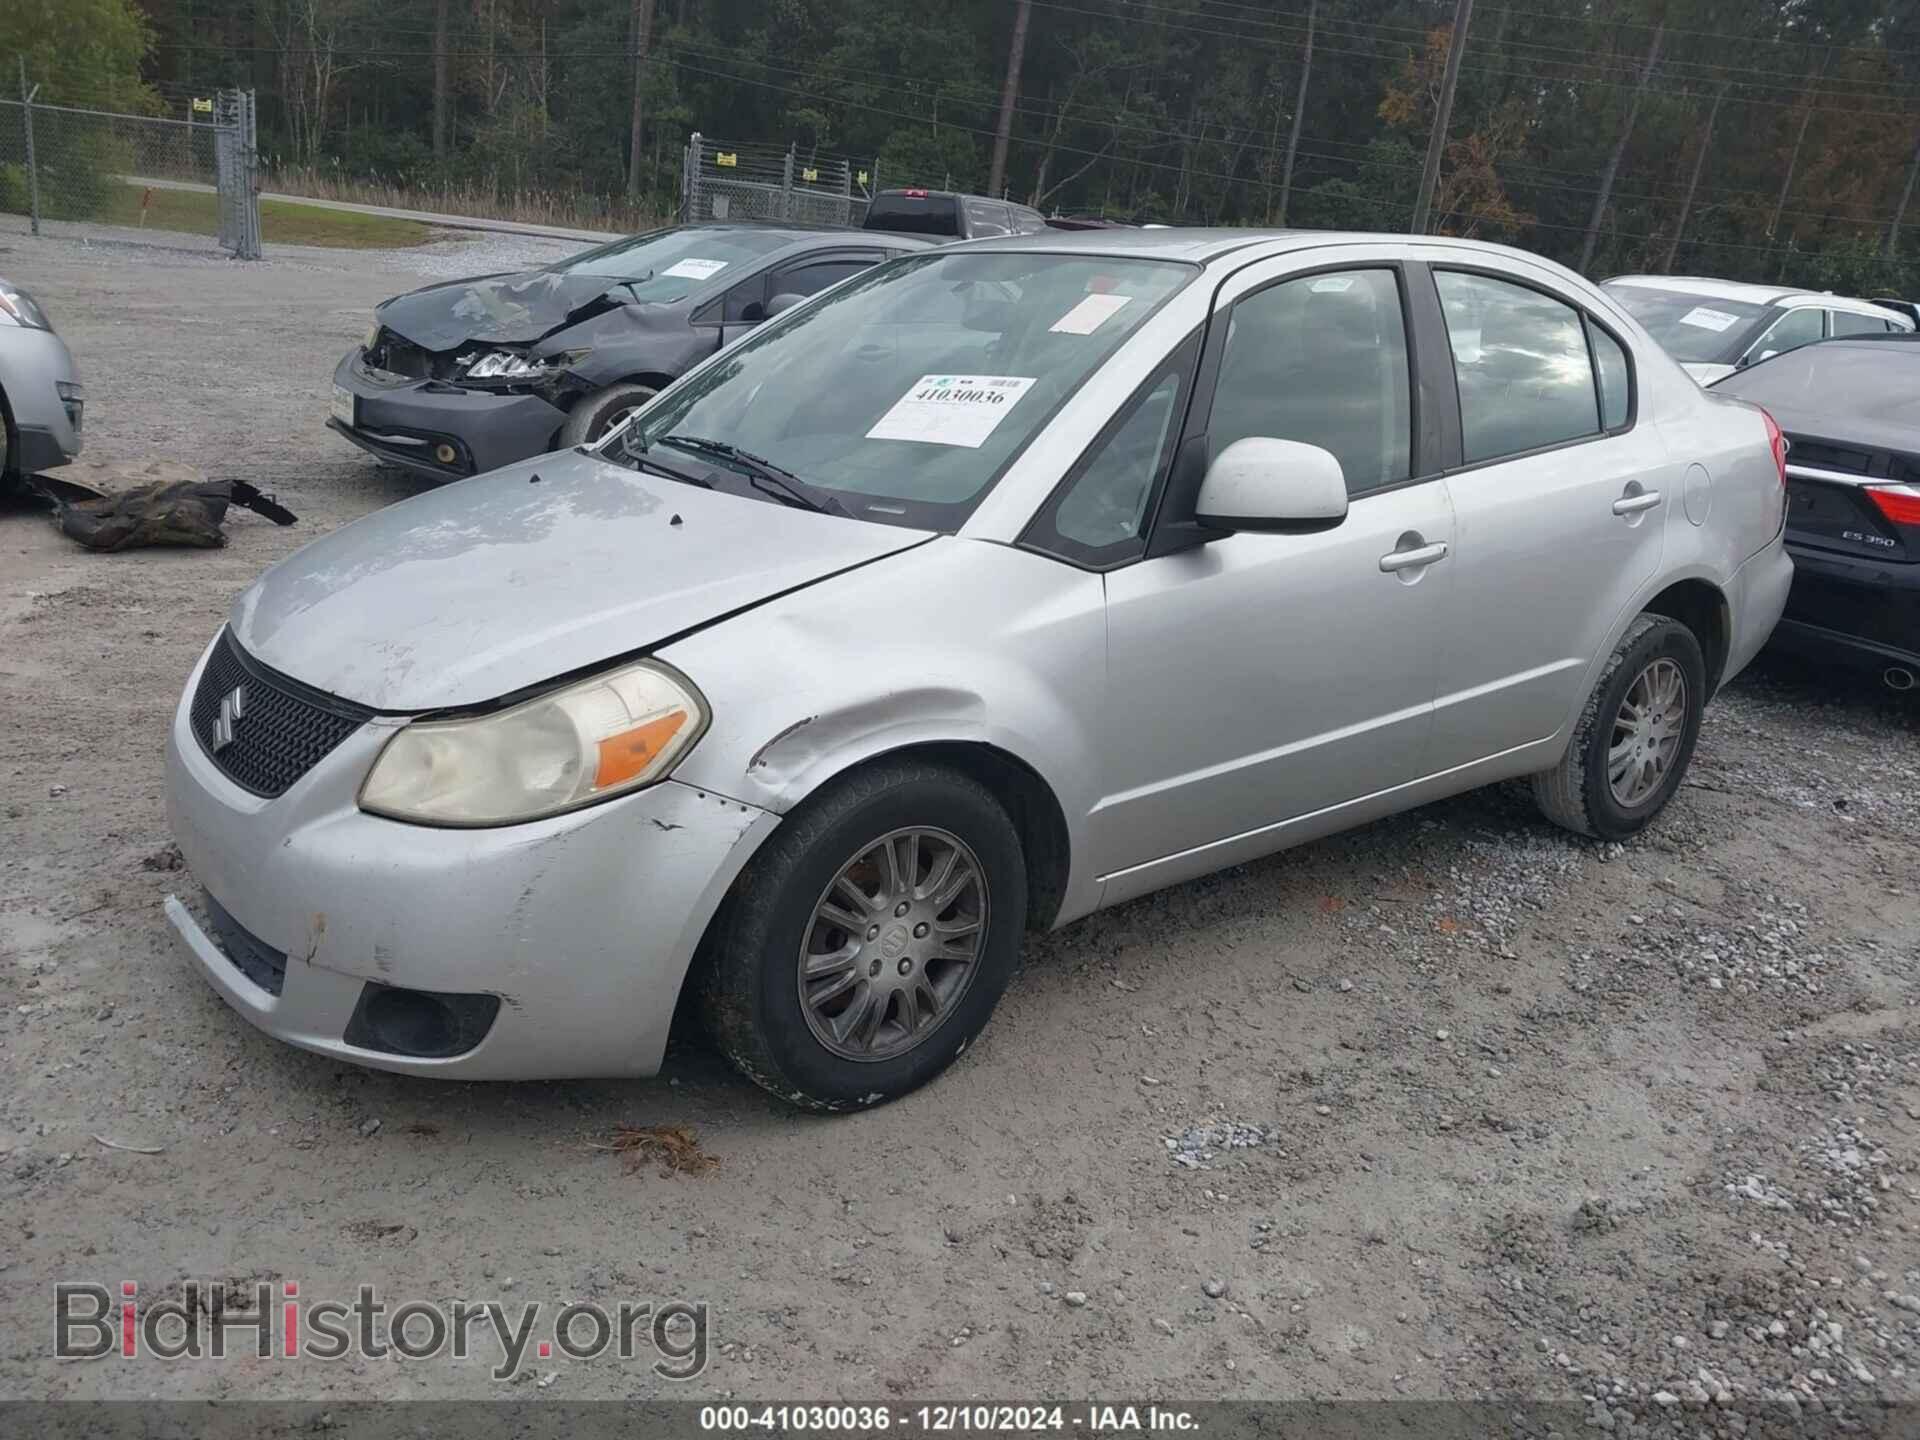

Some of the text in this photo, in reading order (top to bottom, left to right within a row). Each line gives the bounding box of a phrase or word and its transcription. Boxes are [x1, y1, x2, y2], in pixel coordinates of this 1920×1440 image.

[916, 388, 1005, 403] 41030036
[1842, 530, 1895, 547] ES 350
